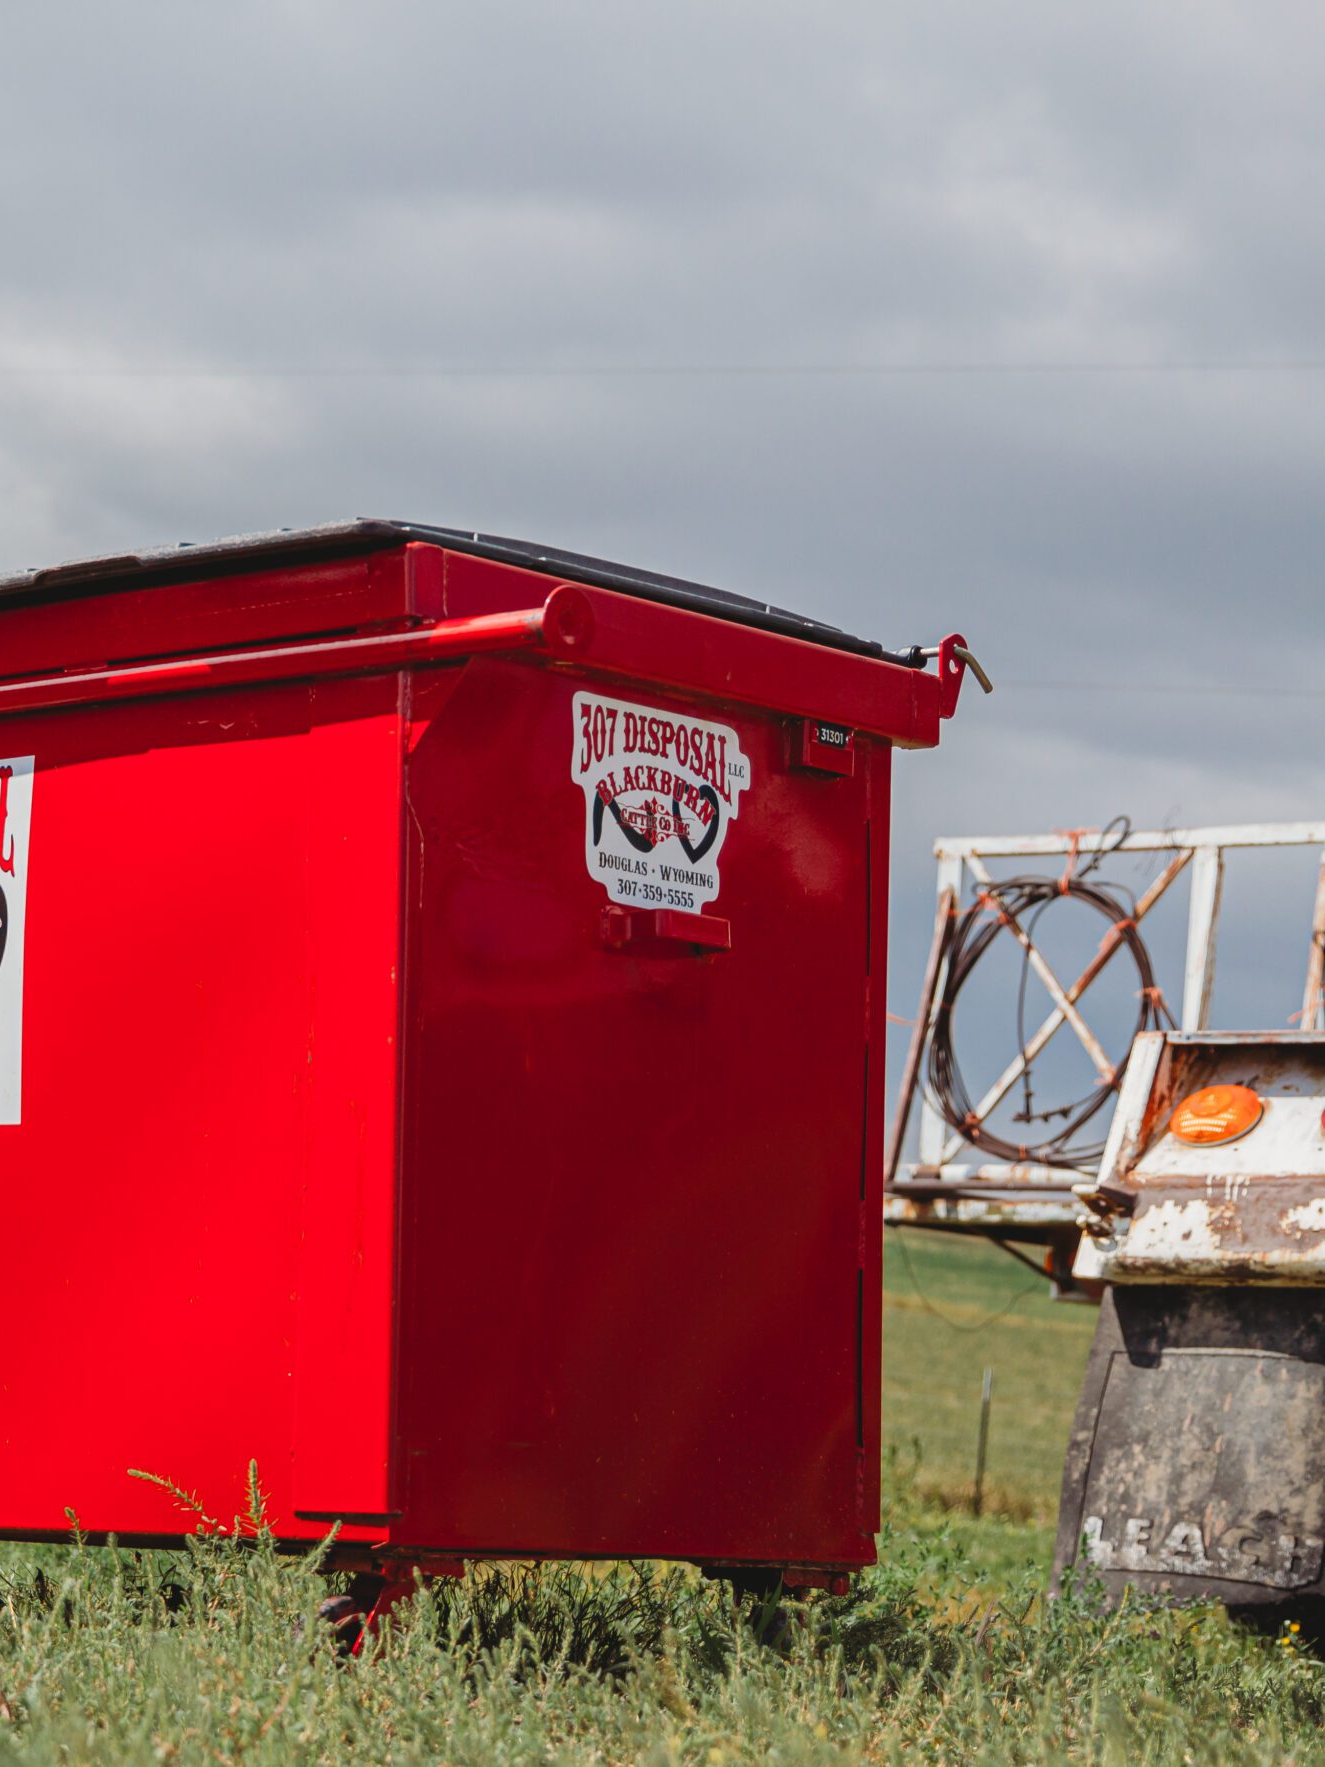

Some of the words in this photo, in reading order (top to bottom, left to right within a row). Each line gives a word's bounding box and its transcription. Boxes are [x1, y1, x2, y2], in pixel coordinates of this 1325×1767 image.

[580, 703, 618, 774] 307
[623, 711, 732, 806] DISPOSAL
[728, 763, 744, 778] LLC
[821, 728, 843, 744] 31301
[595, 765, 716, 827] BLACKBURN
[599, 852, 648, 876] DOUGLAS
[659, 865, 714, 889] WYOMING
